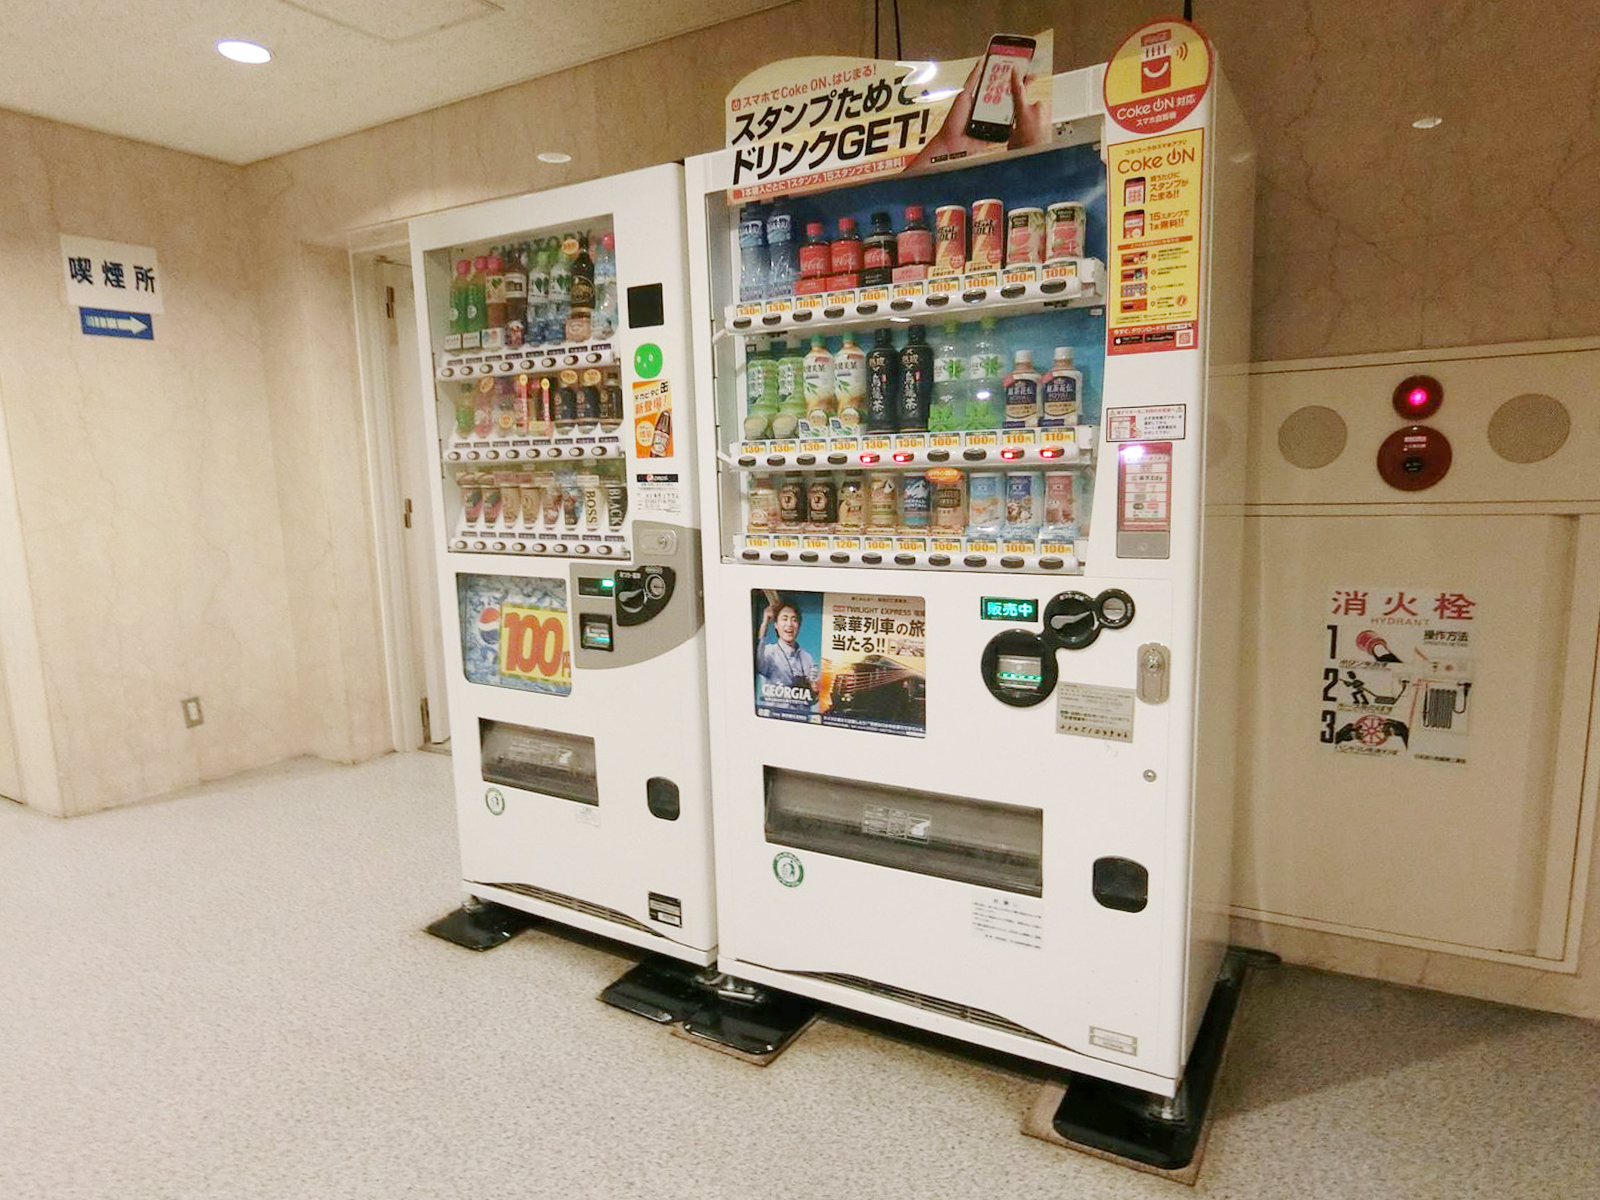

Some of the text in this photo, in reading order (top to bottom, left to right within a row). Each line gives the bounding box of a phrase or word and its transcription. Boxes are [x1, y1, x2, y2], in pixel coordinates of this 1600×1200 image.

[1116, 104, 1151, 120] Coke
[1153, 96, 1175, 112] ON
[733, 109, 930, 186] ドリンクGET!
[1118, 147, 1195, 174] Coke ON
[68, 256, 155, 293] 喫煙所
[585, 490, 598, 524] BOSS
[608, 488, 623, 526] BLACK
[881, 607, 912, 616] EXPRESS
[987, 602, 1033, 617] 販売中
[1331, 590, 1477, 621] 消火栓
[832, 614, 925, 637] 豪華列車の旅
[1370, 617, 1431, 626] HYDRANT
[832, 634, 886, 653] 当たる!!
[1326, 625, 1338, 660] 1
[762, 682, 813, 701] GEORGIA
[1322, 667, 1339, 702] 2
[1320, 710, 1336, 744] 3
